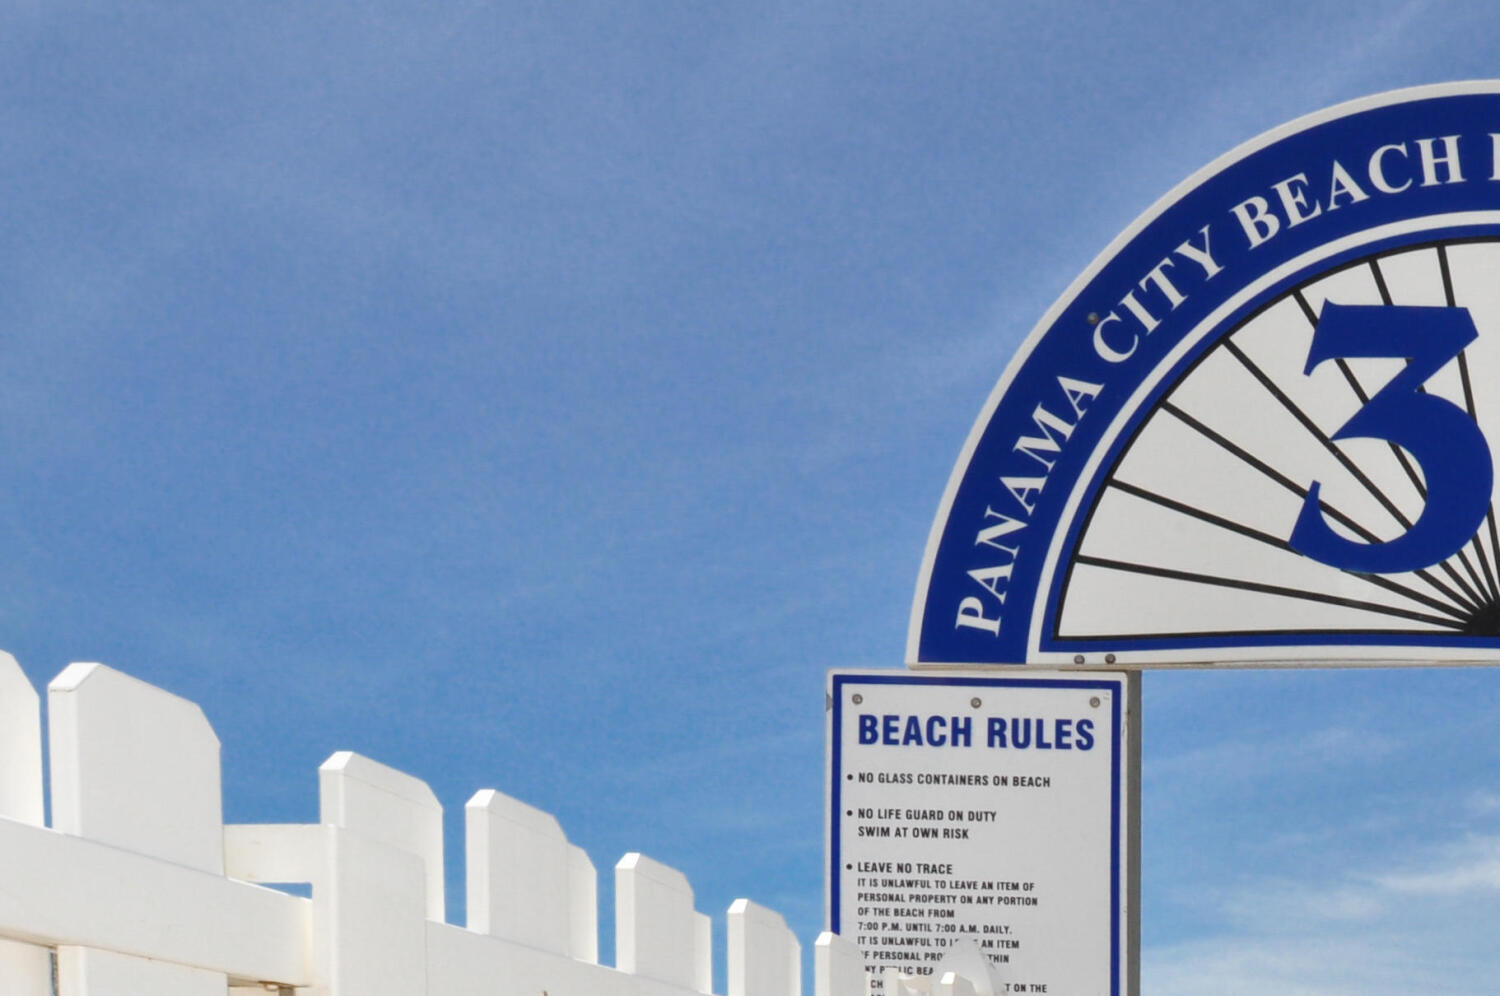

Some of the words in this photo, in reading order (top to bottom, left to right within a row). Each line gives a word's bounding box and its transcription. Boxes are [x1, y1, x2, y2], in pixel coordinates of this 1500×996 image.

[955, 375, 1104, 637] PANAMA
[1092, 224, 1225, 364] CITY
[1229, 134, 1467, 250] BEACH
[858, 713, 972, 748] BEACH
[987, 717, 1095, 751] RULES
[858, 773, 874, 784] NO
[878, 773, 913, 784] GLASS
[917, 774, 989, 786] CONTAINERS
[993, 775, 1008, 786] ON
[1012, 776, 1051, 787] BEACH
[858, 808, 874, 820] NO
[877, 809, 902, 820] LIFE
[905, 809, 944, 821] GUARD
[948, 810, 964, 822] ON
[968, 810, 997, 822] DUTY
[858, 826, 891, 838] SWIM
[894, 827, 909, 838] AT
[912, 827, 939, 839] OWN
[943, 828, 969, 839] RISK
[858, 862, 892, 874] LEAVE
[897, 863, 912, 874] NO
[916, 863, 952, 875] TRACE
[857, 878, 866, 888] IT
[869, 878, 879, 888] IS
[881, 878, 932, 889] UNLAWFUL
[934, 880, 947, 890] TO
[949, 880, 978, 890] LEAVE
[981, 881, 994, 891] AN
[996, 882, 1020, 891] ITEM
[1022, 882, 1035, 892] OF
[858, 892, 906, 903] PERSONAL
[909, 894, 957, 904] PROPERTY
[960, 895, 973, 905] ON
[976, 895, 994, 905] ANY
[997, 896, 1038, 906] PORTION
[857, 907, 870, 917] OF
[872, 907, 891, 917] THE
[893, 907, 925, 918] BEACH
[927, 908, 955, 918] FROM
[858, 921, 879, 932] 7:00
[881, 922, 903, 932] P.M.
[905, 922, 933, 933] UNTIL
[935, 923, 957, 934] 7:00
[959, 923, 980, 934] A.M.
[983, 924, 1013, 935] DAILY.
[858, 936, 866, 946] IT
[869, 936, 878, 946] IS
[882, 936, 932, 947] UNLAWFUL
[935, 937, 947, 947] TO
[981, 939, 994, 949] AN
[997, 939, 1019, 949] ITEM
[873, 951, 921, 961] PERSONAL
[1014, 984, 1026, 992] ON
[1030, 984, 1047, 993] THE
